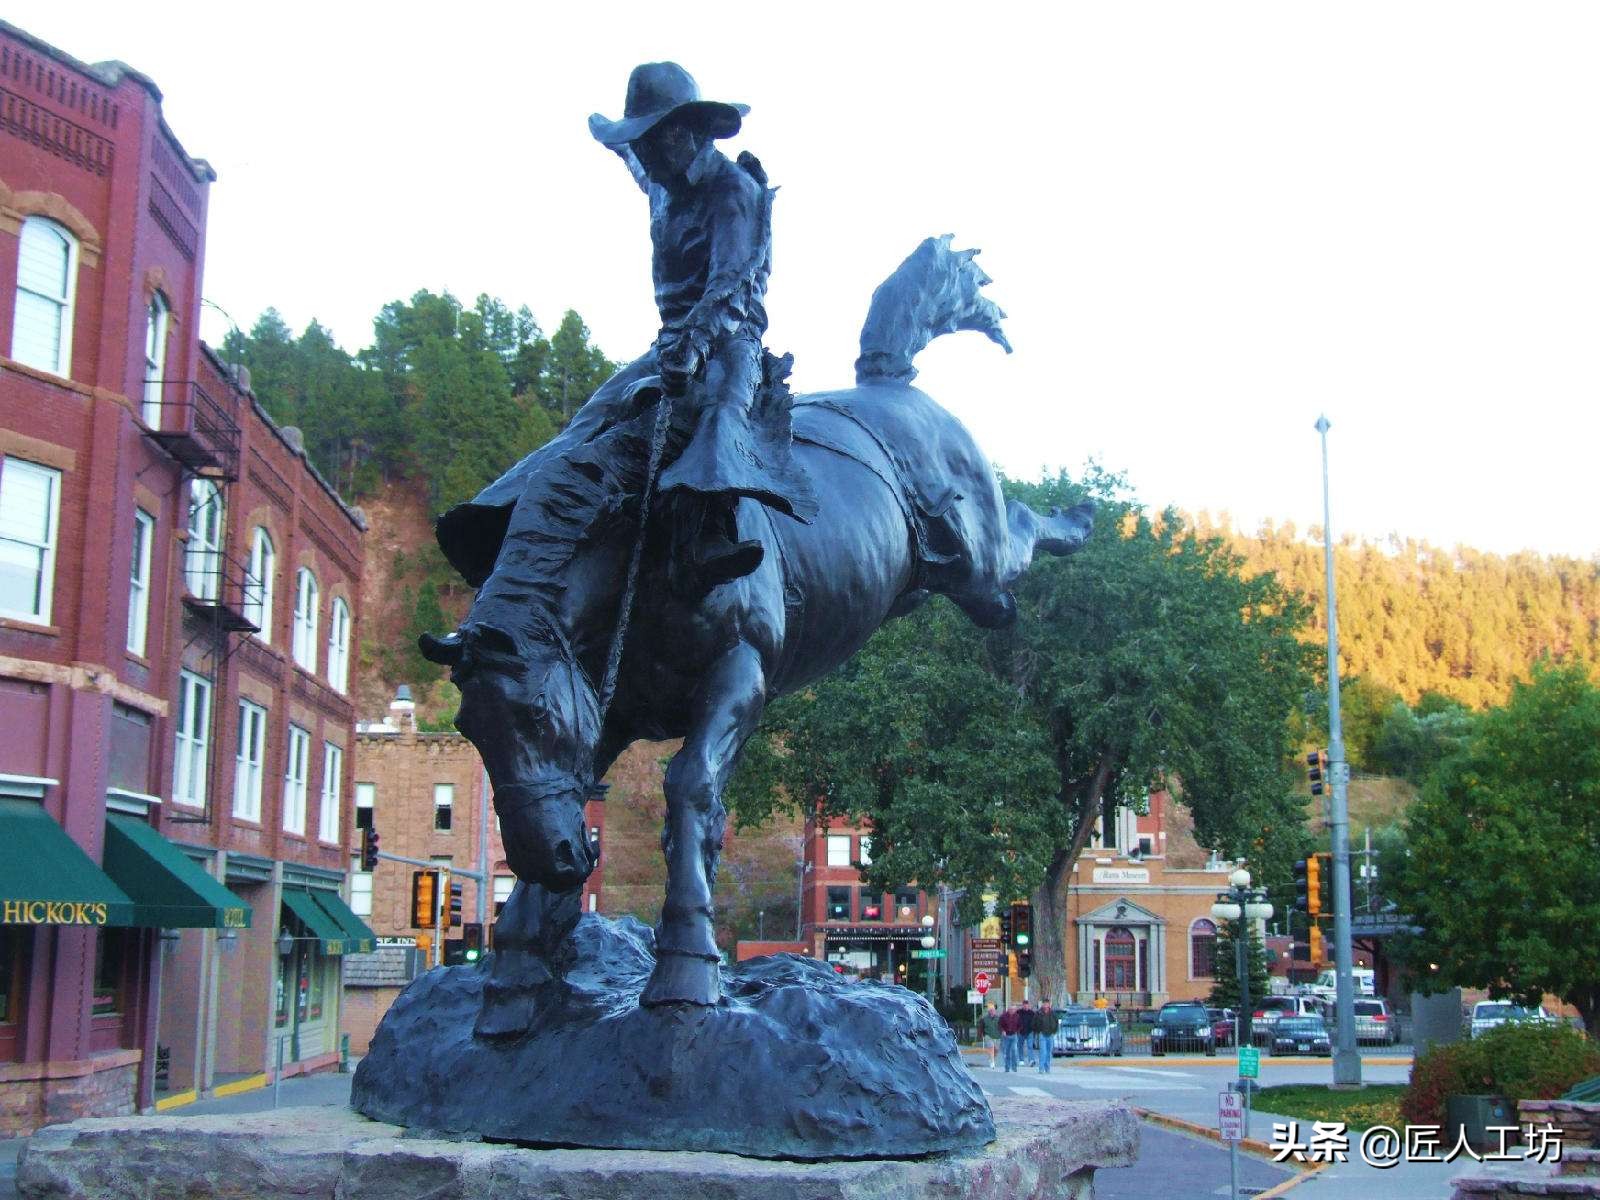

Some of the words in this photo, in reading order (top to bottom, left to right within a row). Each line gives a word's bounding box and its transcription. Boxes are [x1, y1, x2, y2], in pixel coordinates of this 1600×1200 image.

[3, 900, 107, 925] HICKOK'S
[1225, 1095, 1234, 1106] NO
[1220, 1109, 1241, 1117] PARKING
